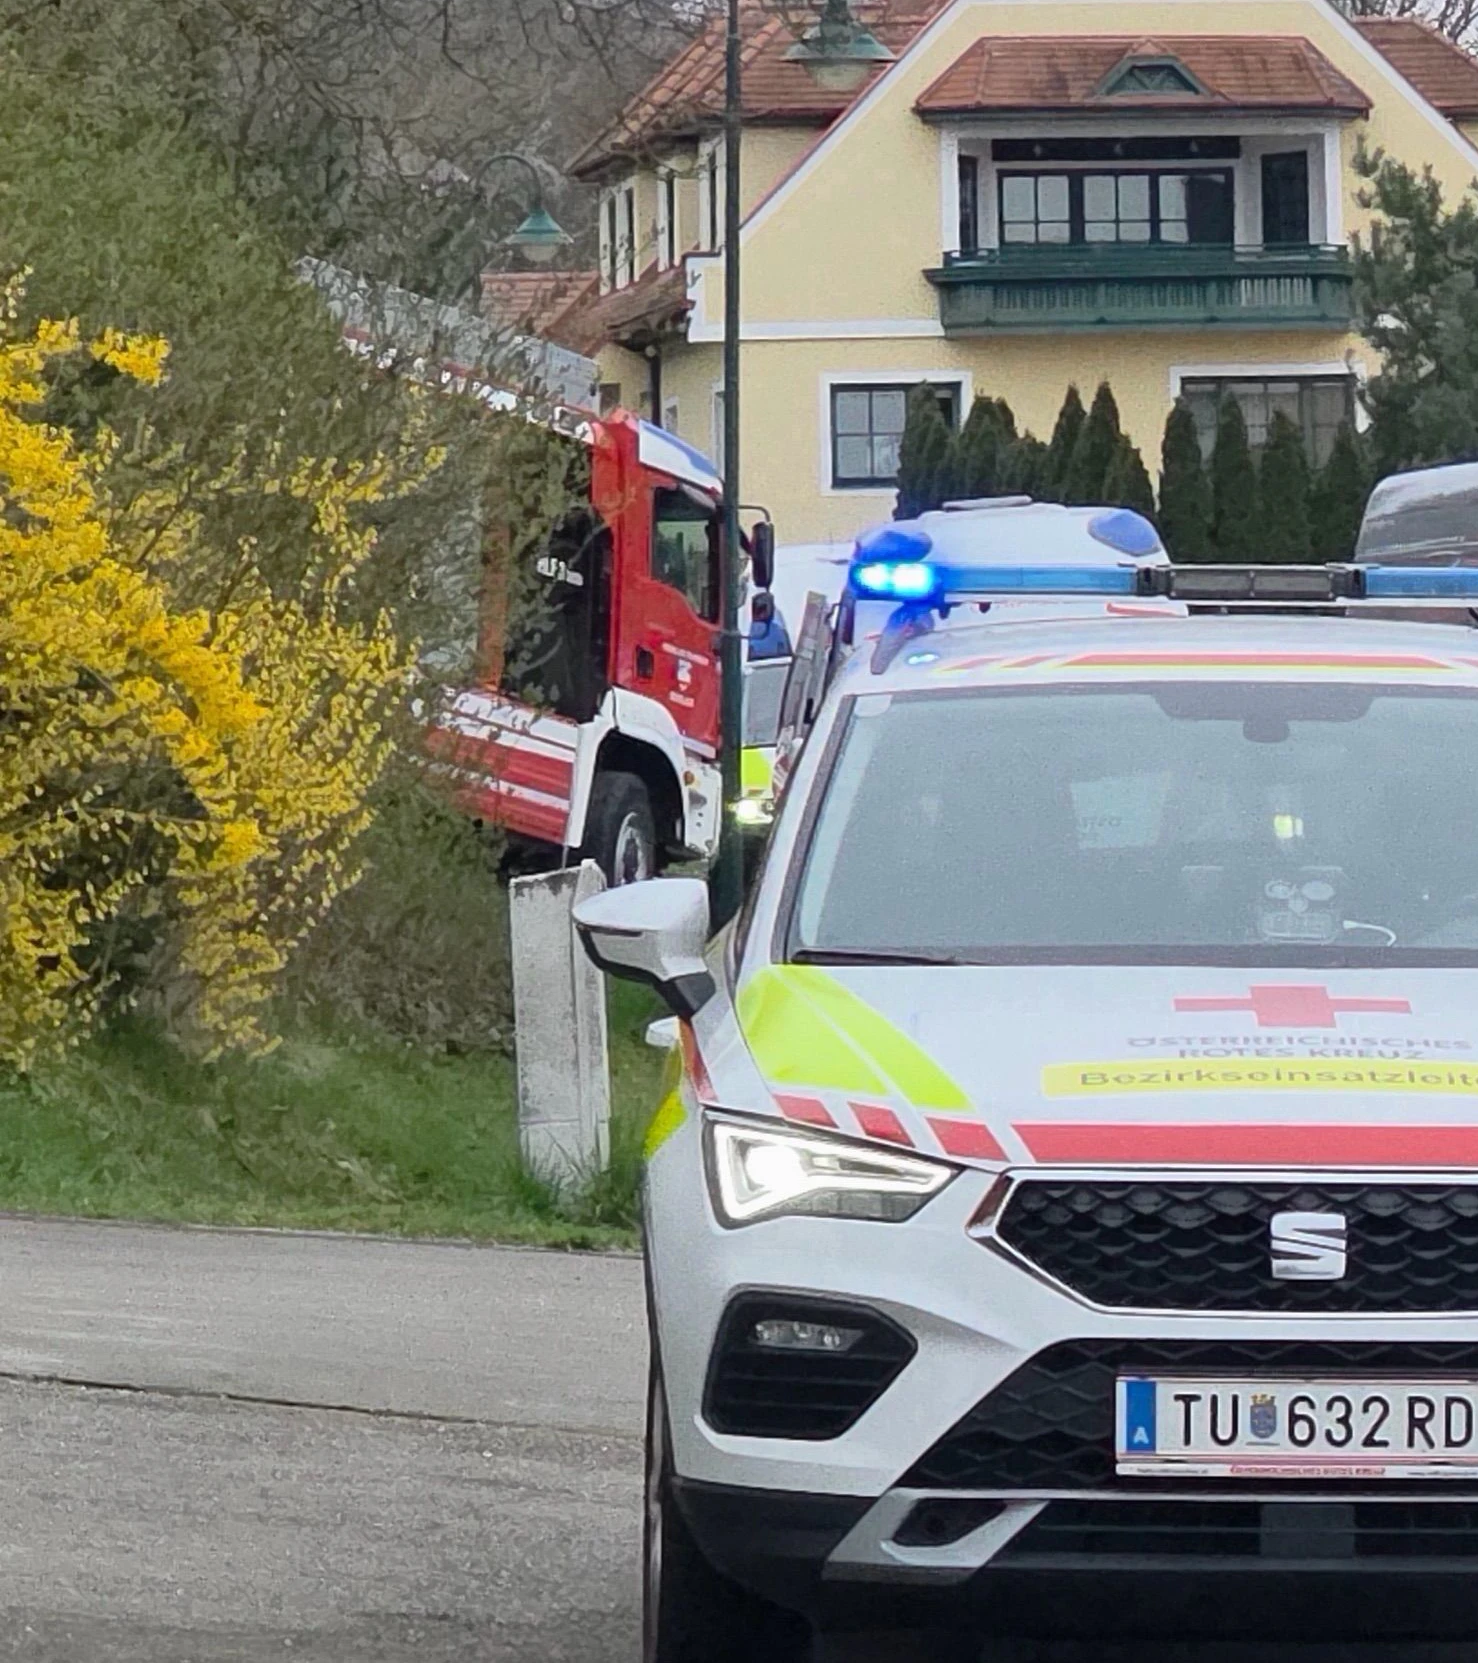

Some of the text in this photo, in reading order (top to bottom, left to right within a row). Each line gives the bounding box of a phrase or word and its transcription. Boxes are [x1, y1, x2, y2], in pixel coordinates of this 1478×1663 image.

[1179, 1049, 1424, 1060] ROTES KREUZ
[1173, 1393, 1239, 1447] TU
[1133, 1427, 1150, 1444] A
